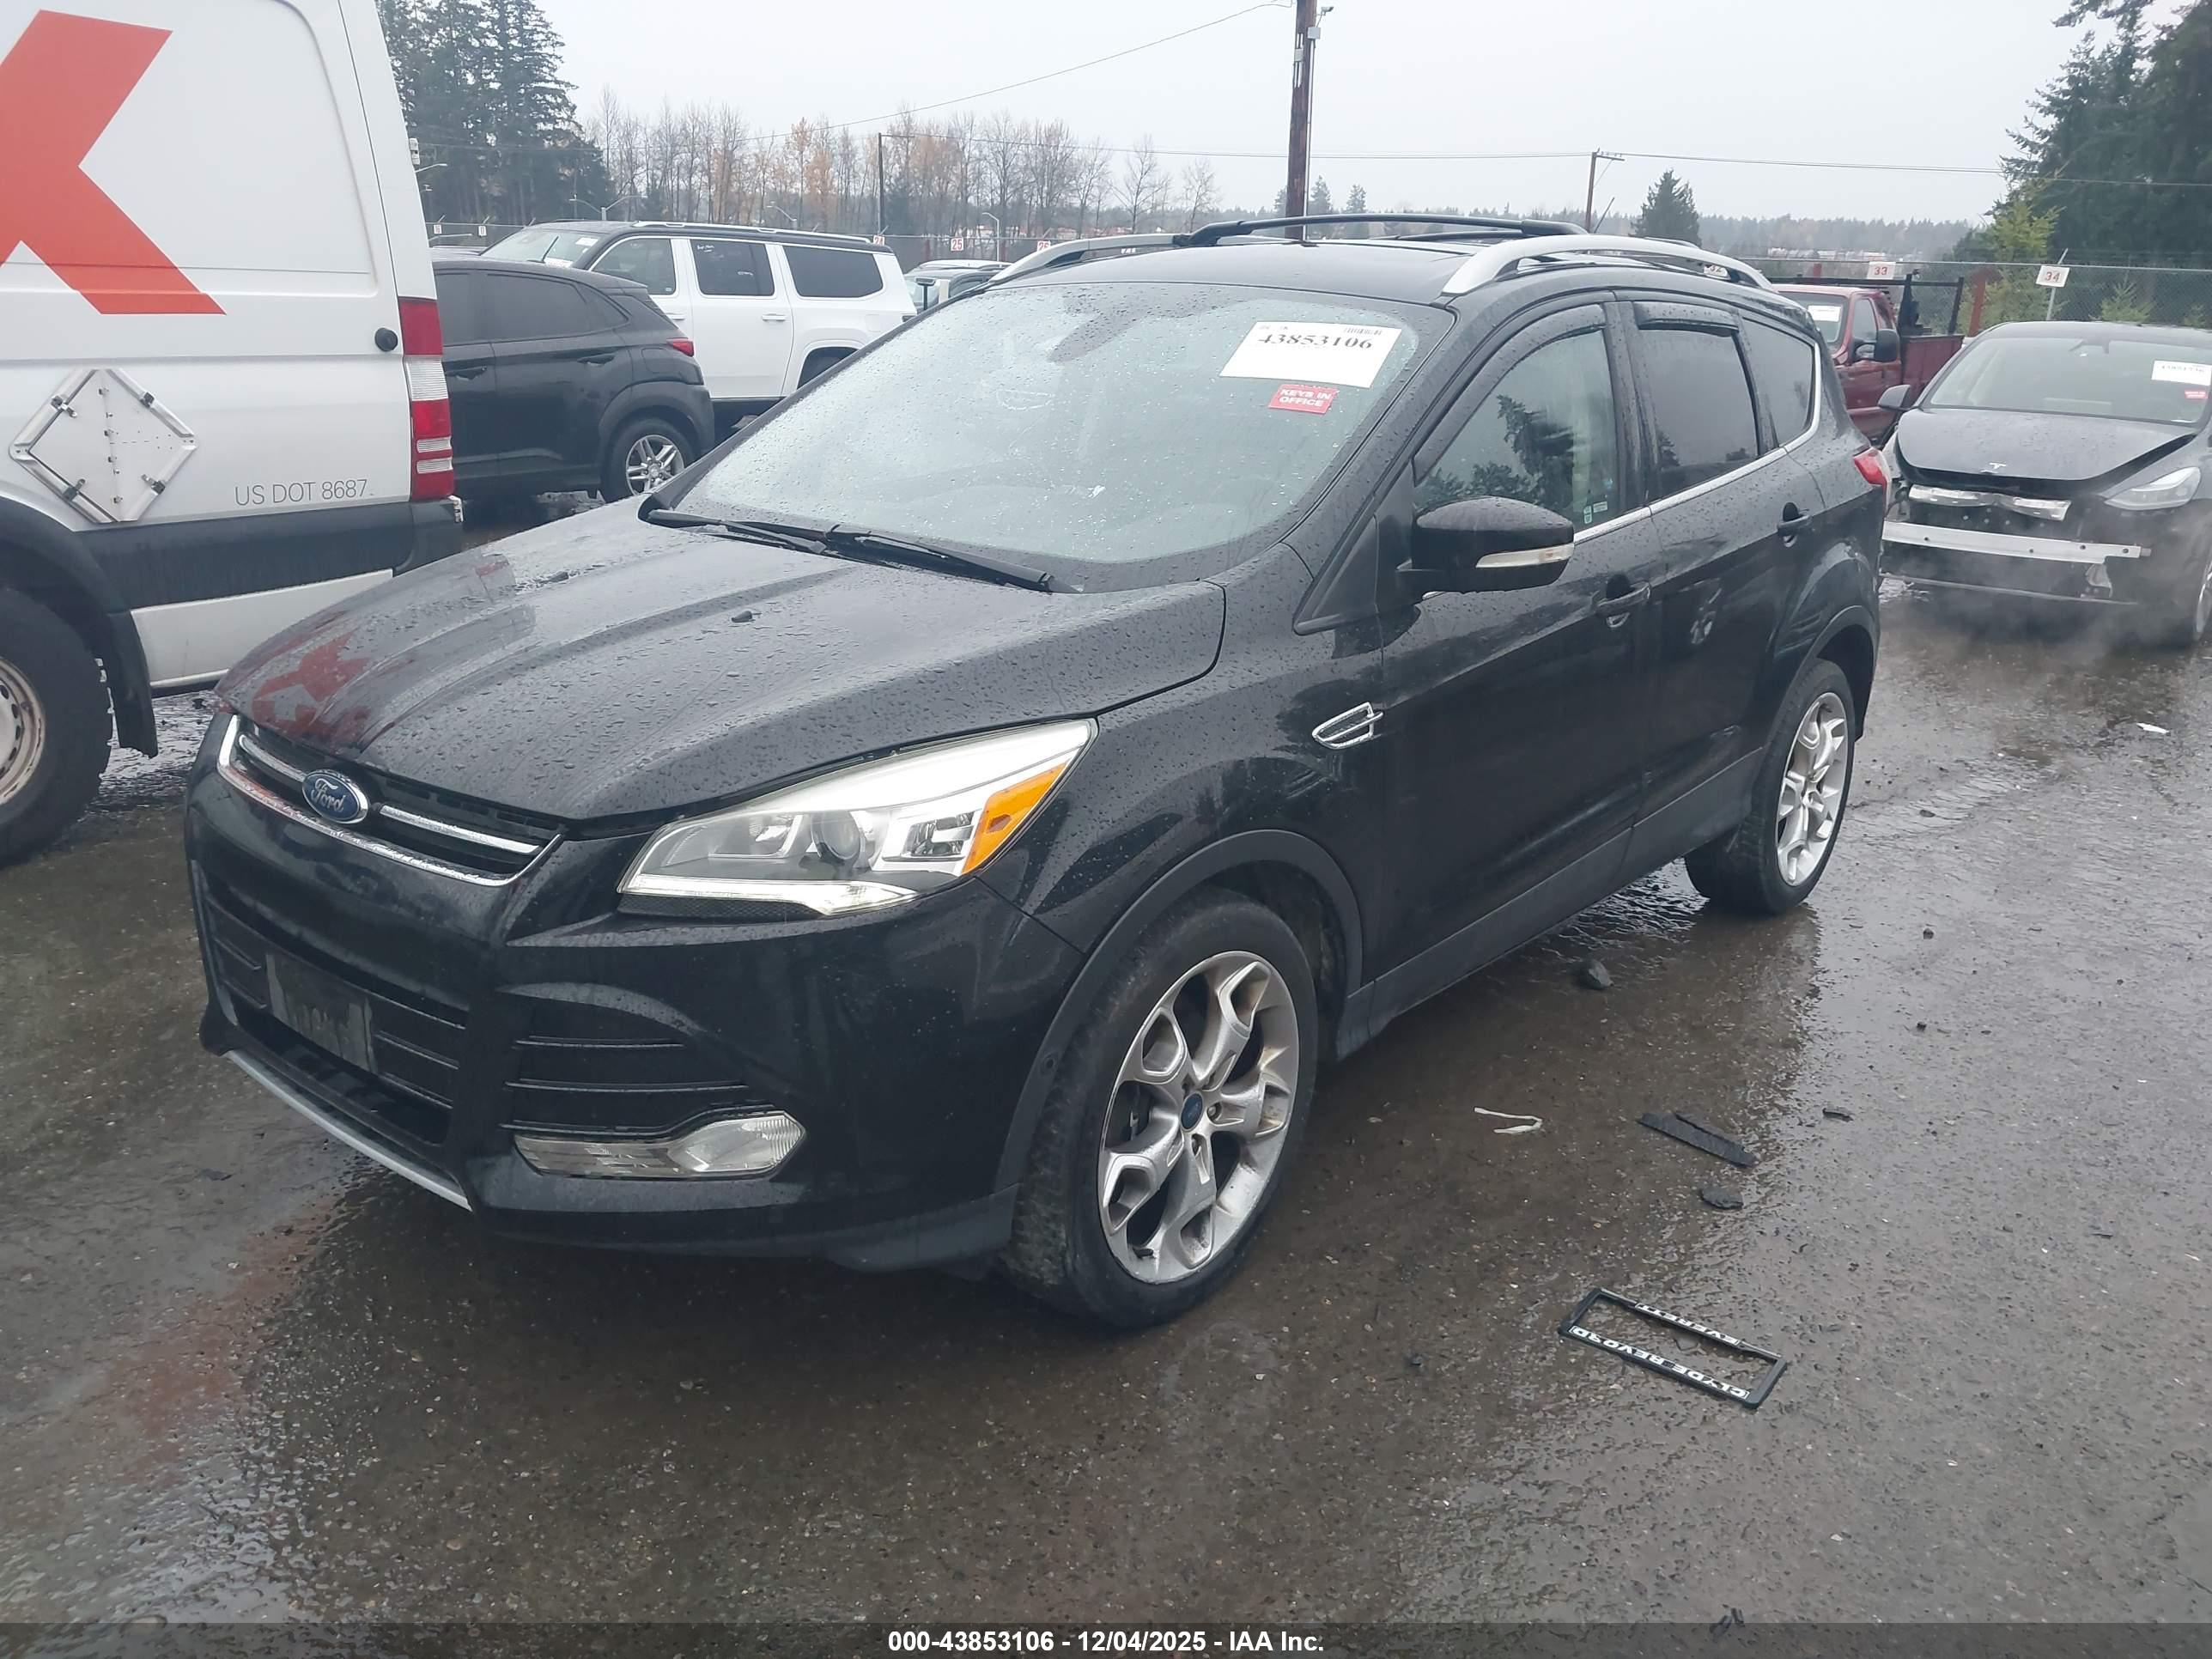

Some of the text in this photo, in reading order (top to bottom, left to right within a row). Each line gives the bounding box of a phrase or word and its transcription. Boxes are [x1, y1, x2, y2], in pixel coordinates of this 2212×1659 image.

[952, 240, 963, 250] 25
[1874, 266, 1888, 276] 33
[2045, 271, 2060, 283] 34
[1258, 333, 1373, 349] 43853106
[1279, 389, 1332, 400] KEYS IN
[1279, 396, 1325, 407] OFFICE
[234, 478, 368, 507] US DOT 8687
[310, 778, 347, 812] Ford
[1640, 1304, 1739, 1344] EVERETT
[1672, 1363, 1747, 1398] CLYDE
